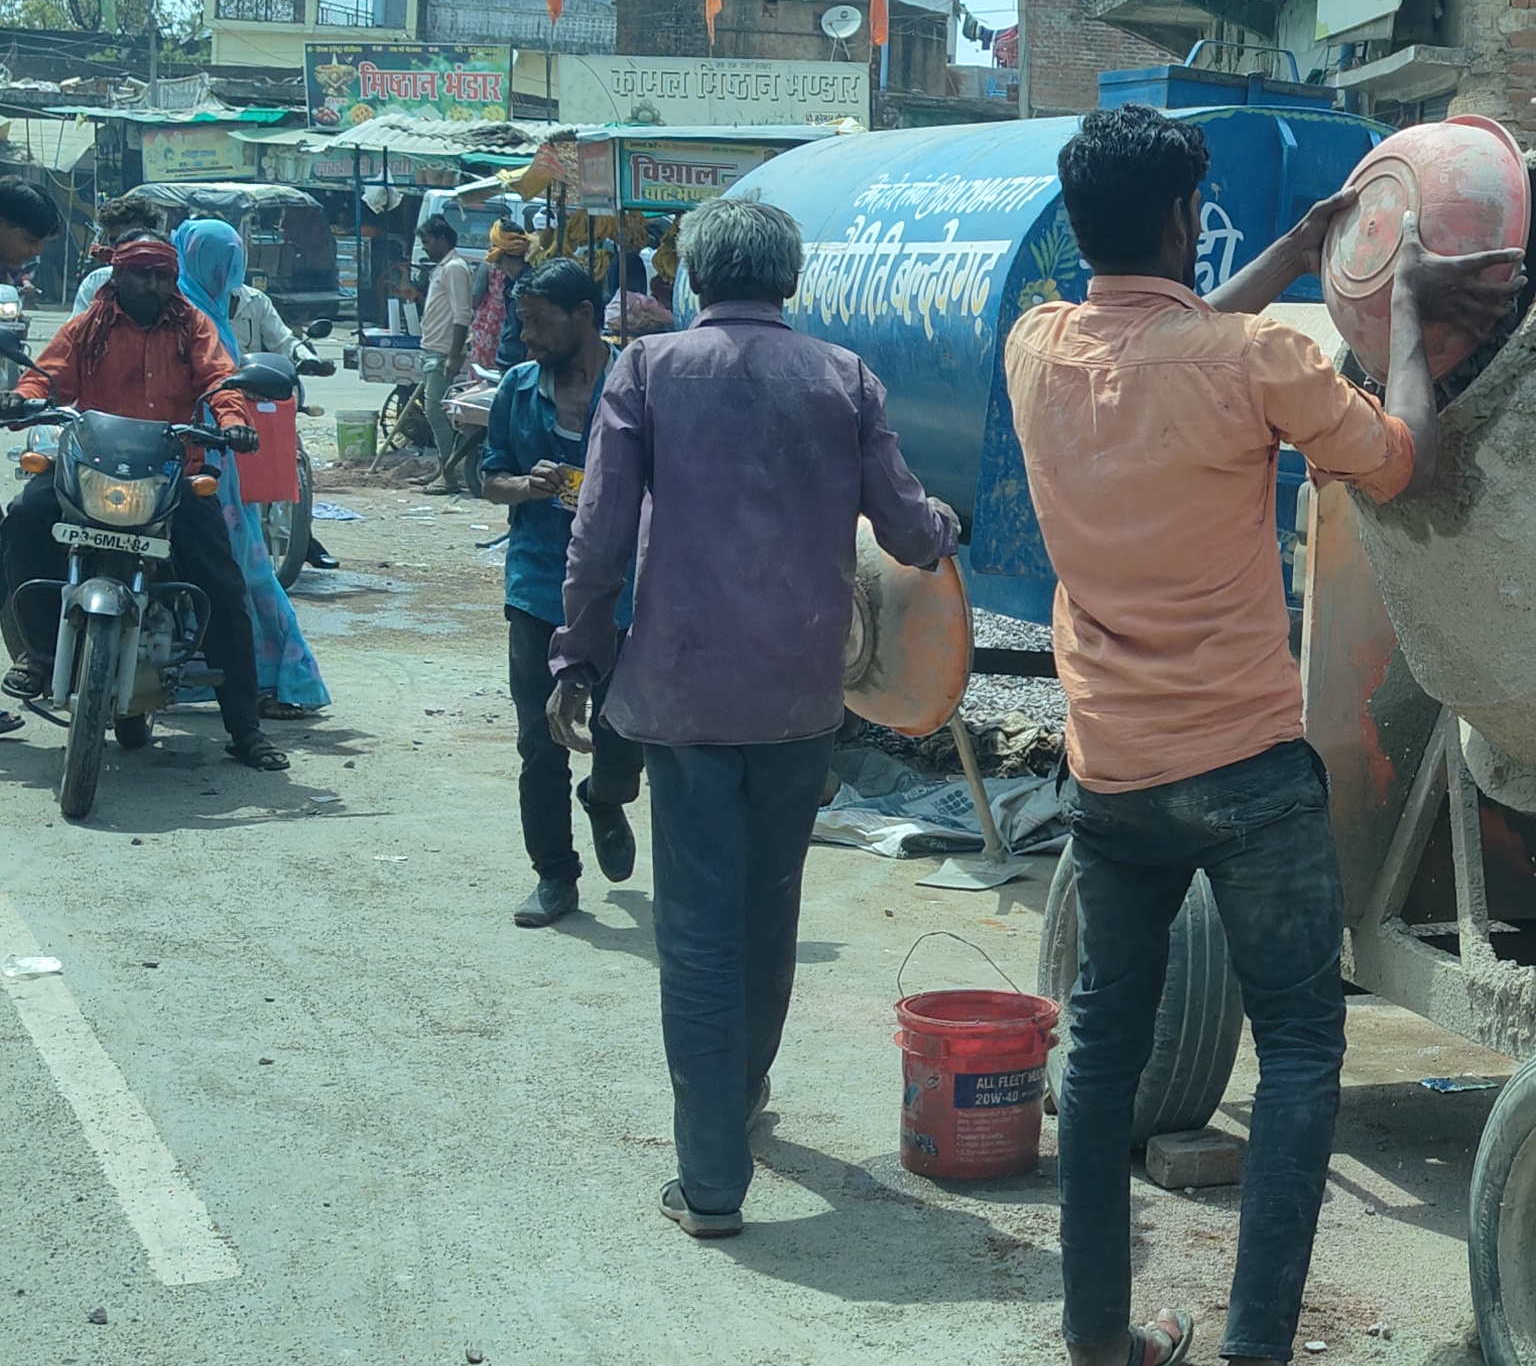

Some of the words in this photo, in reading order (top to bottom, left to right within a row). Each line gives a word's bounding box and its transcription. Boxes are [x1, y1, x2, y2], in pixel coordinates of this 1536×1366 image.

[359, 61, 439, 101] मिष्ठान
[444, 64, 502, 101] भंडार
[631, 154, 737, 200] विशाल
[999, 1072, 1027, 1088] FLEET
[975, 1091, 1018, 1105] 20W-40
